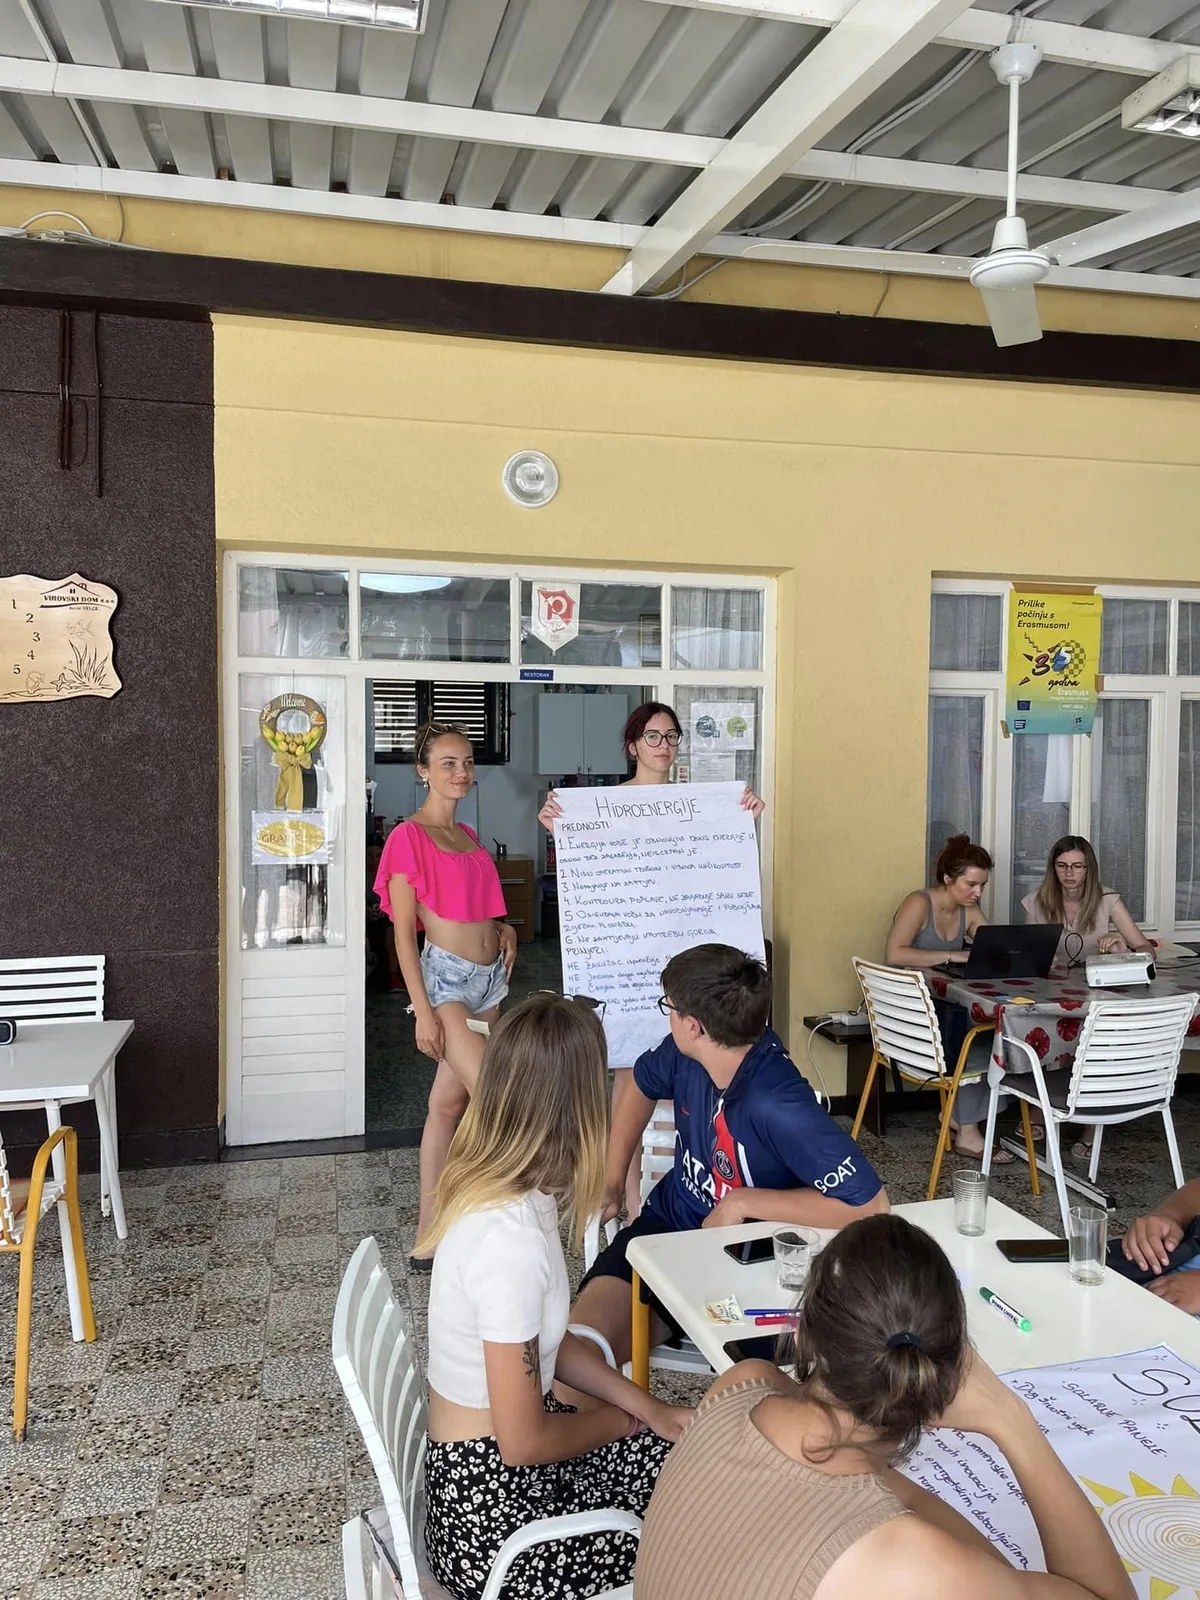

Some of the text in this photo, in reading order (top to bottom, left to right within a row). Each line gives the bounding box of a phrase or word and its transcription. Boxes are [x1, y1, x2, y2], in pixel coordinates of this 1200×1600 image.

[12, 599, 17, 609] 1
[1018, 599, 1045, 608] Prilike
[25, 612, 34, 623] 2
[1017, 610, 1048, 620] počinju
[1017, 620, 1070, 629] Erasmusom!
[32, 632, 41, 642] 3
[27, 649, 36, 660] 4
[13, 664, 21, 675] 5
[1048, 676, 1080, 691] godina
[280, 694, 306, 708] Welcome
[814, 1157, 857, 1194] GOAT
[925, 1457, 973, 1508] energetskim
